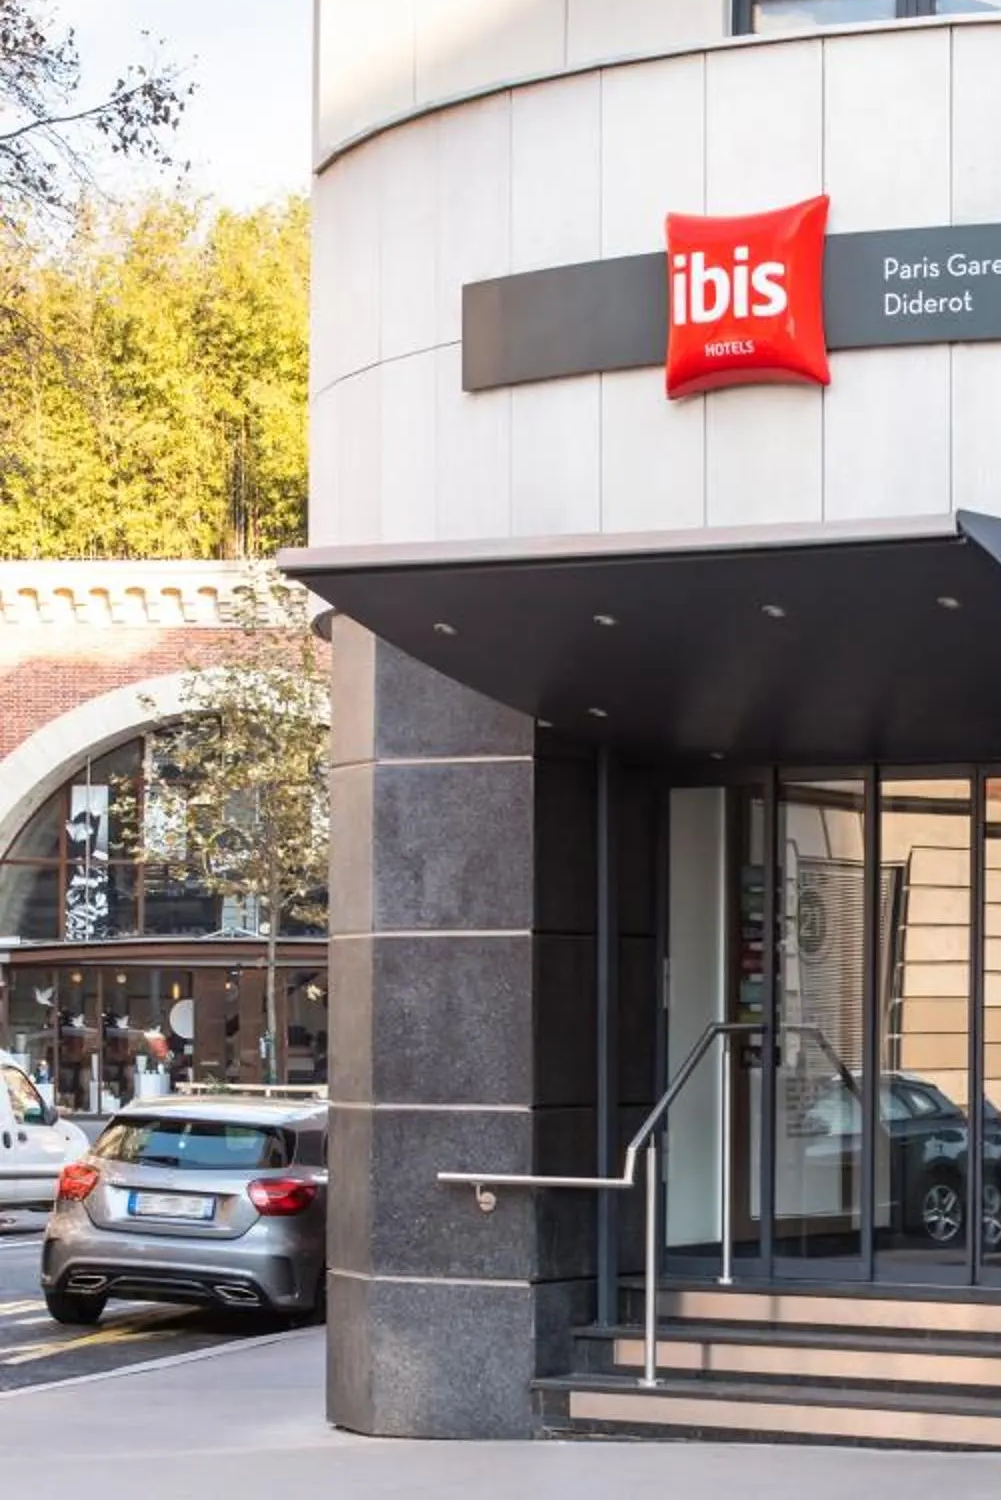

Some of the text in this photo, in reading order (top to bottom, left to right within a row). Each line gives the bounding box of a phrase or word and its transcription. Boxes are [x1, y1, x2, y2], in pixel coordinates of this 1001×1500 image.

[884, 256, 941, 281] Paris
[673, 245, 788, 326] ibis
[884, 289, 973, 316] Diderot
[704, 340, 755, 357] HOTELS
